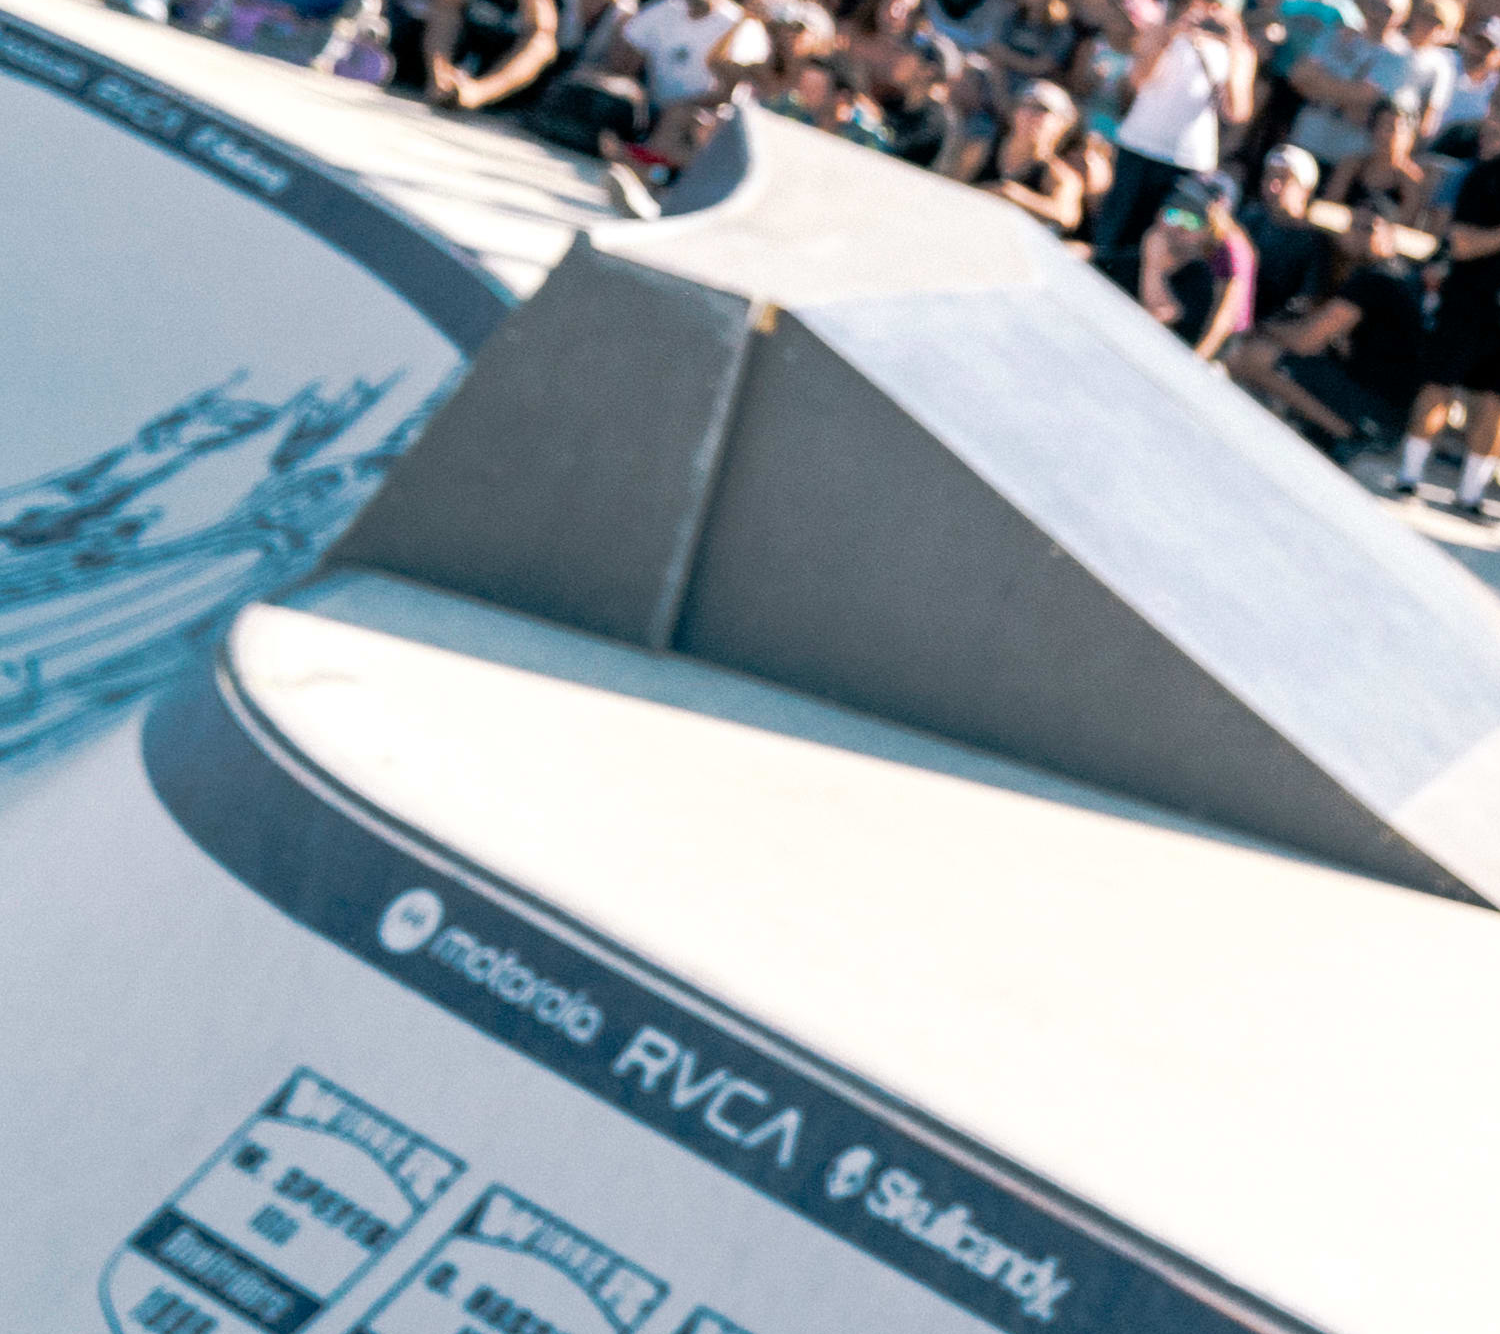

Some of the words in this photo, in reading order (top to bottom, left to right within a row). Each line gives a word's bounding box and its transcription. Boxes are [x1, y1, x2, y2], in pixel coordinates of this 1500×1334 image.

[430, 926, 603, 1044] motorola
[612, 1025, 802, 1167] RVCA
[865, 1168, 1072, 1322] Skullcandy
